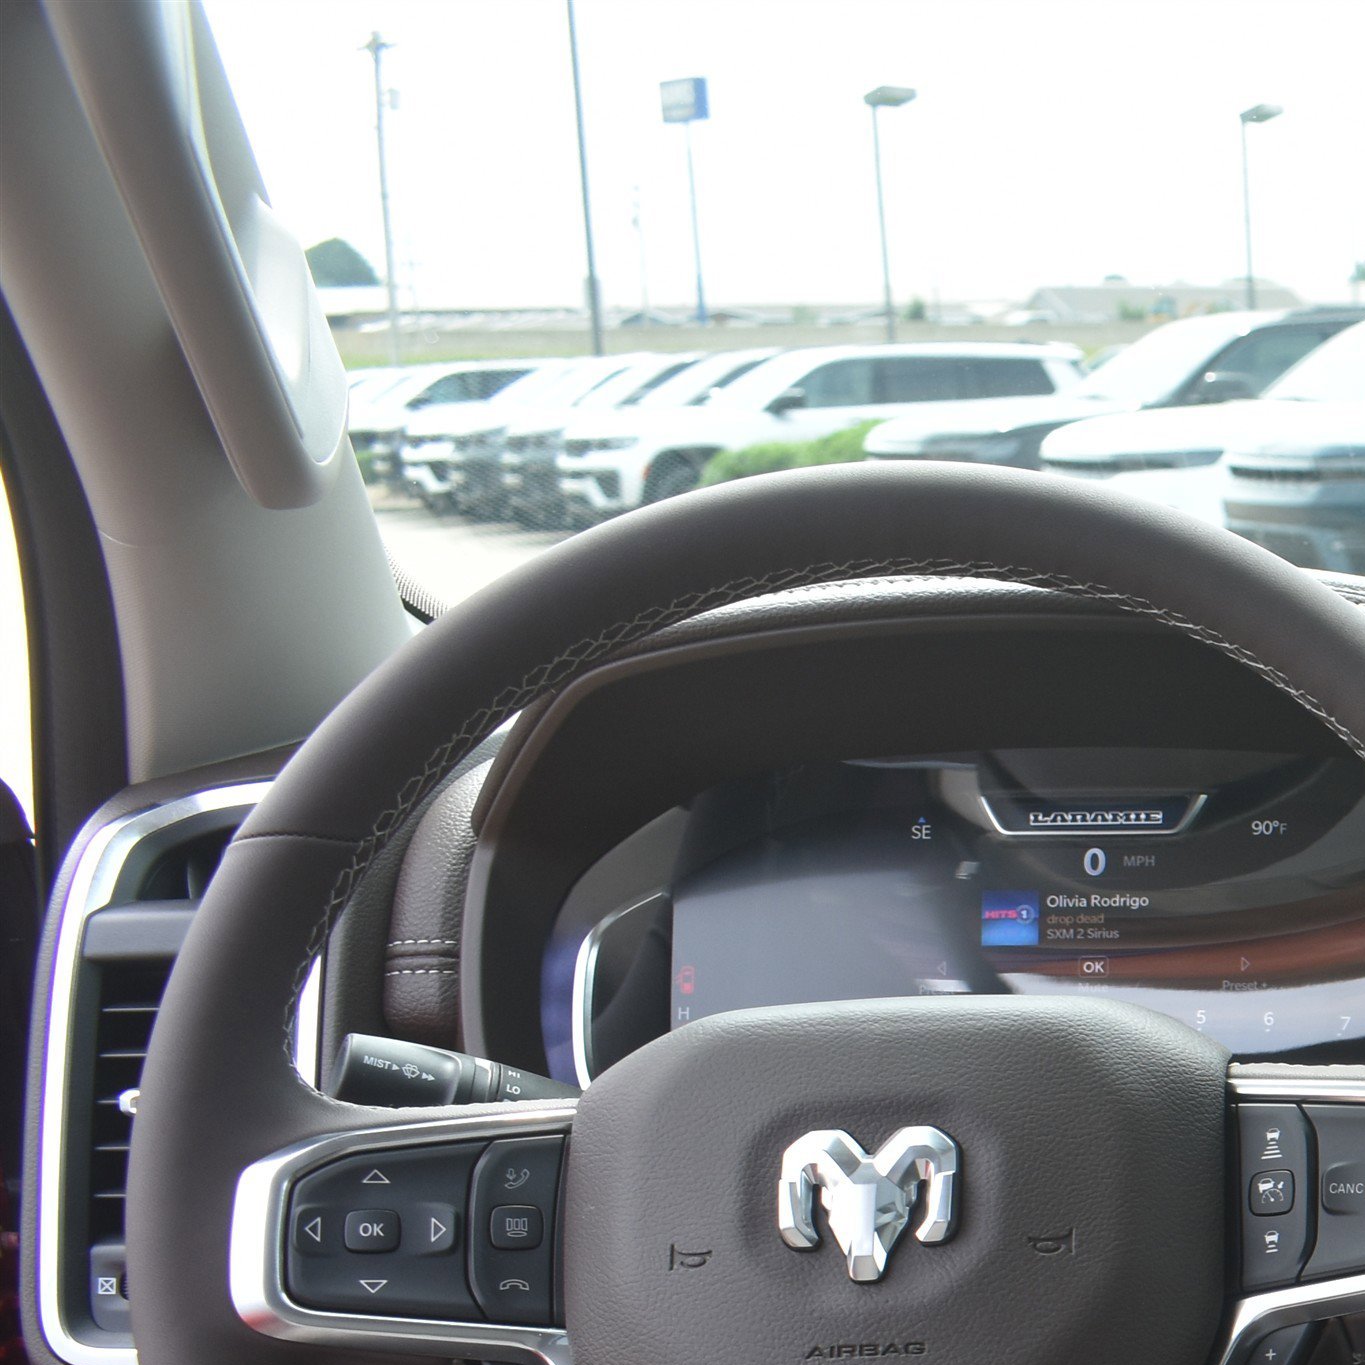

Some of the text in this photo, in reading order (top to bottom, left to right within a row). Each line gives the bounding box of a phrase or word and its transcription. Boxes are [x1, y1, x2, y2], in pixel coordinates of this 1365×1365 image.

[1029, 810, 1163, 826] LARAMIE
[911, 825, 932, 840] SE
[1083, 847, 1156, 876] 0 MPH
[1046, 894, 1149, 910] Olivia Rodrigo
[984, 909, 1017, 919] HITS
[1046, 912, 1105, 927] drop dead
[1046, 928, 1120, 940] SXM 2 Sirius
[1083, 961, 1105, 974] OK
[1222, 980, 1259, 993] Preset
[678, 1006, 690, 1020] H
[1196, 1009, 1351, 1031] 5 6 7
[363, 1055, 391, 1070] MIST
[506, 1084, 521, 1095] LO
[1329, 1183, 1364, 1194] CANC
[358, 1222, 385, 1239] OK
[805, 1342, 927, 1360] AIRBAG
